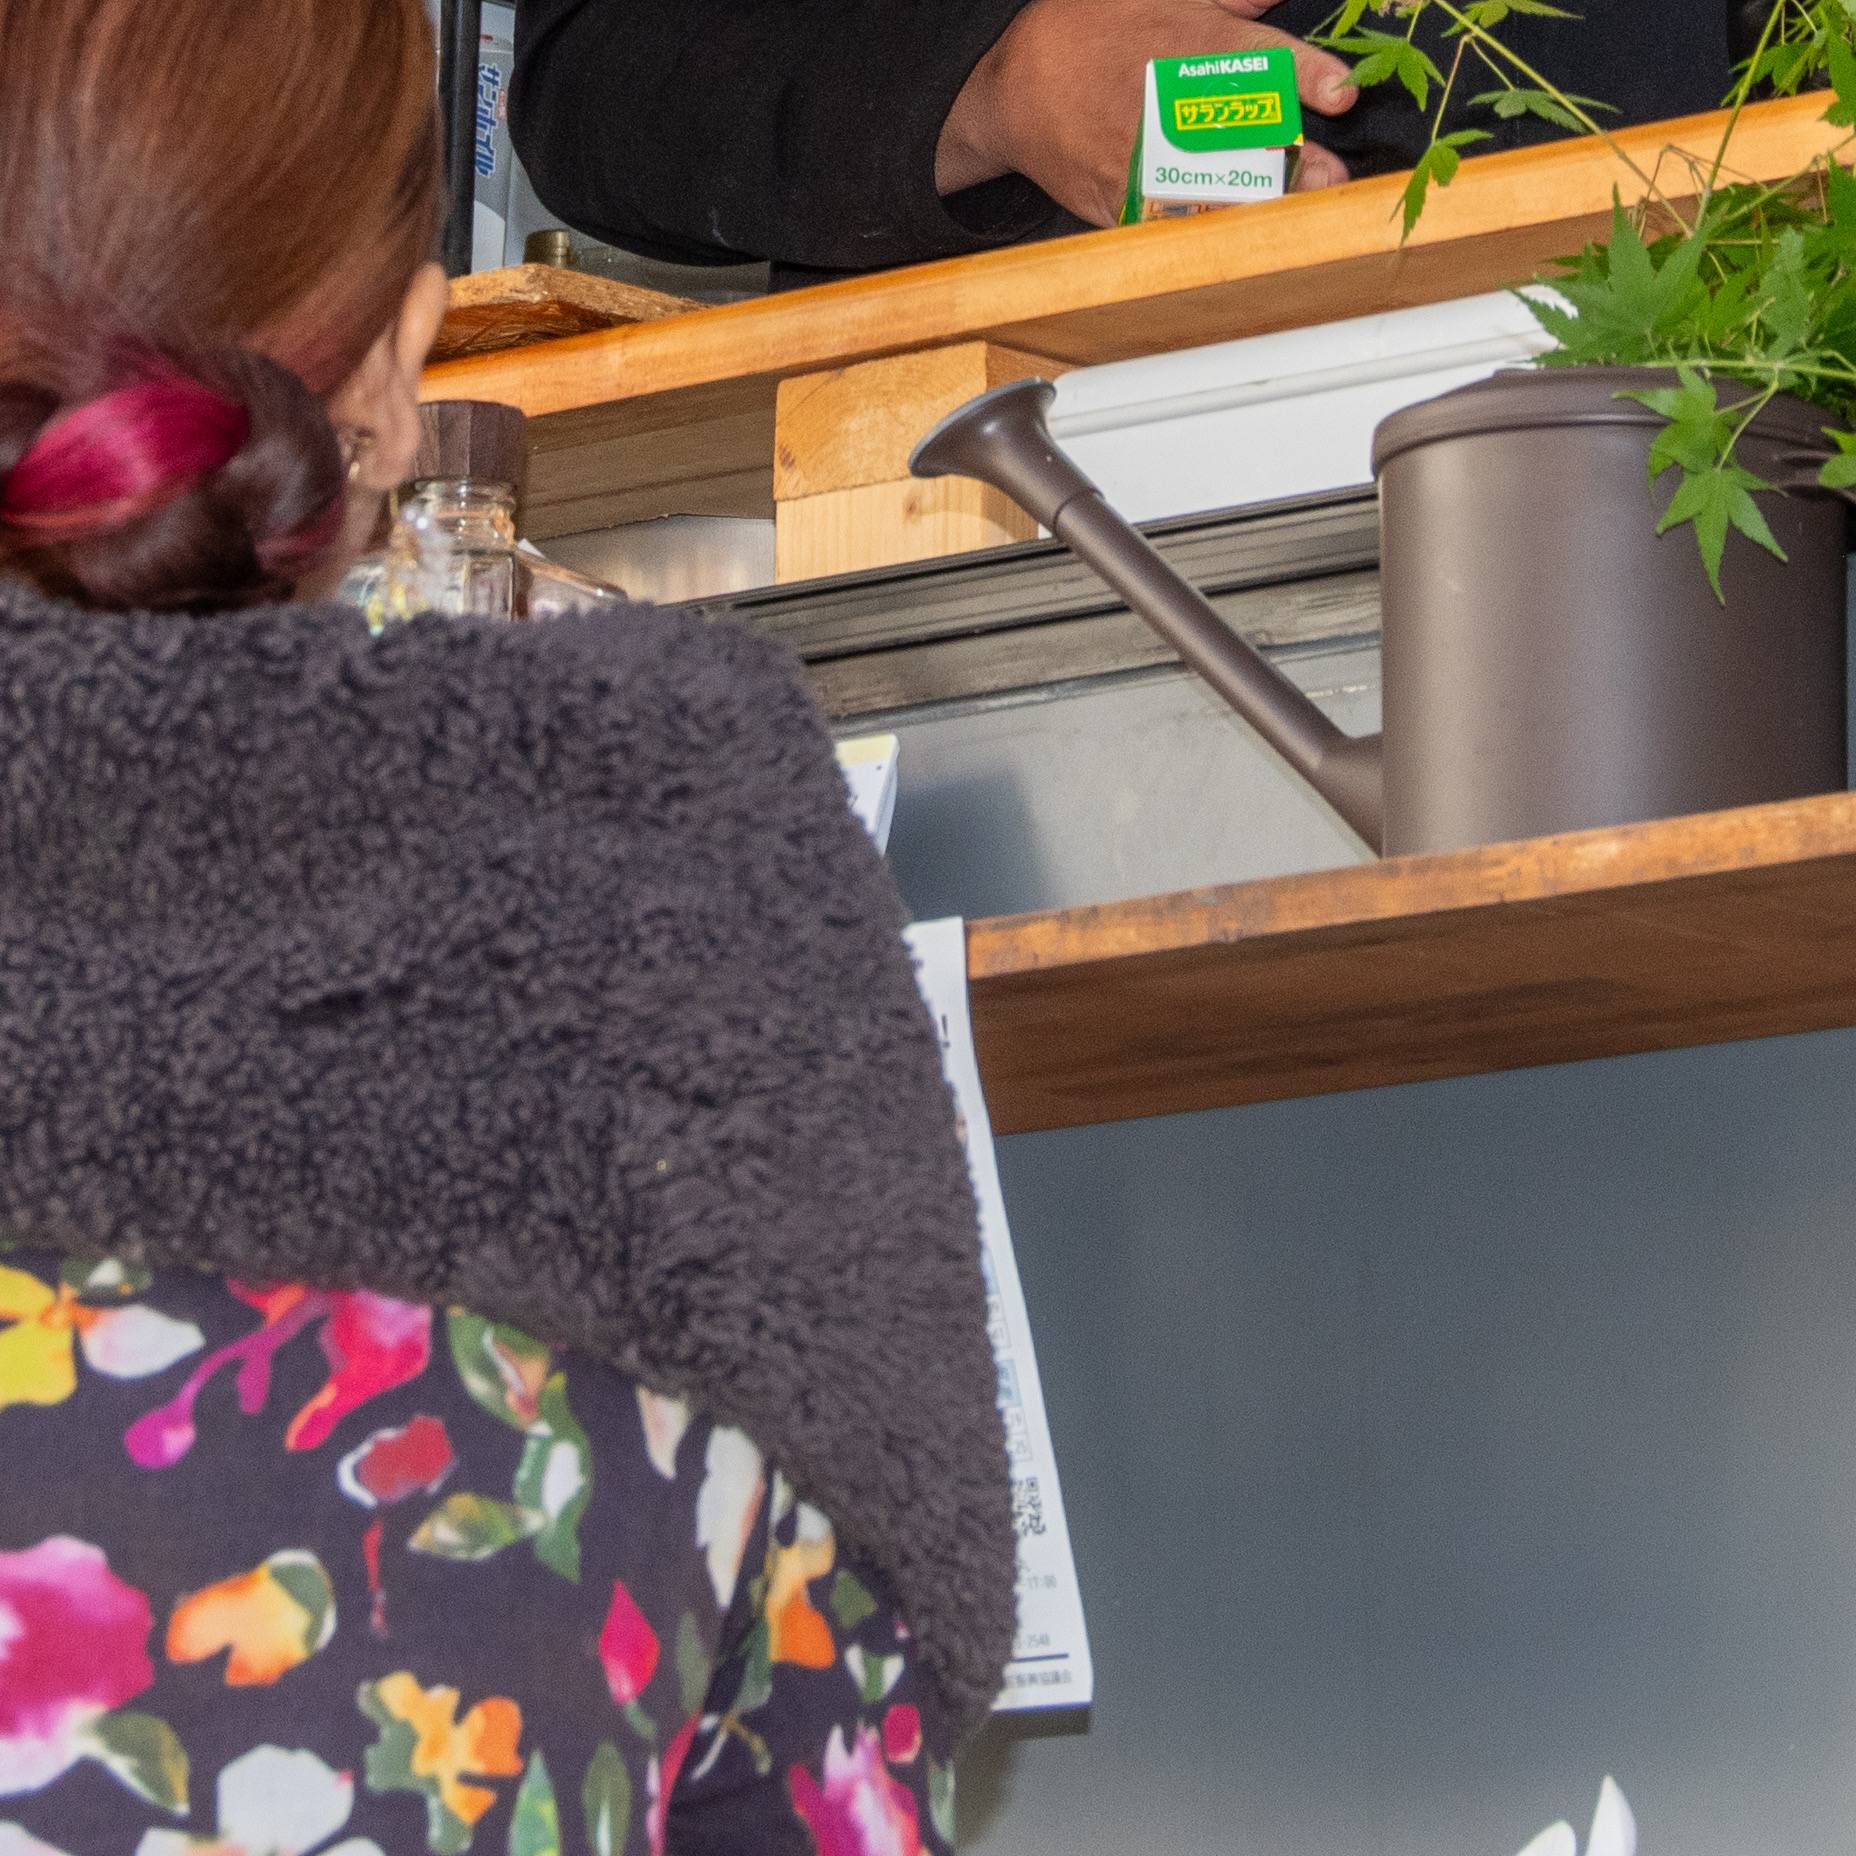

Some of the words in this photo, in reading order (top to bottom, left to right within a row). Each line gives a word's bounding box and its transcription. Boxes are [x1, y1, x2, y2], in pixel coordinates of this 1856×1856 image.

[1178, 56, 1269, 77] AsahiKASEI
[1180, 97, 1277, 126] サランラップ
[1155, 167, 1273, 188] 30cm×20m
